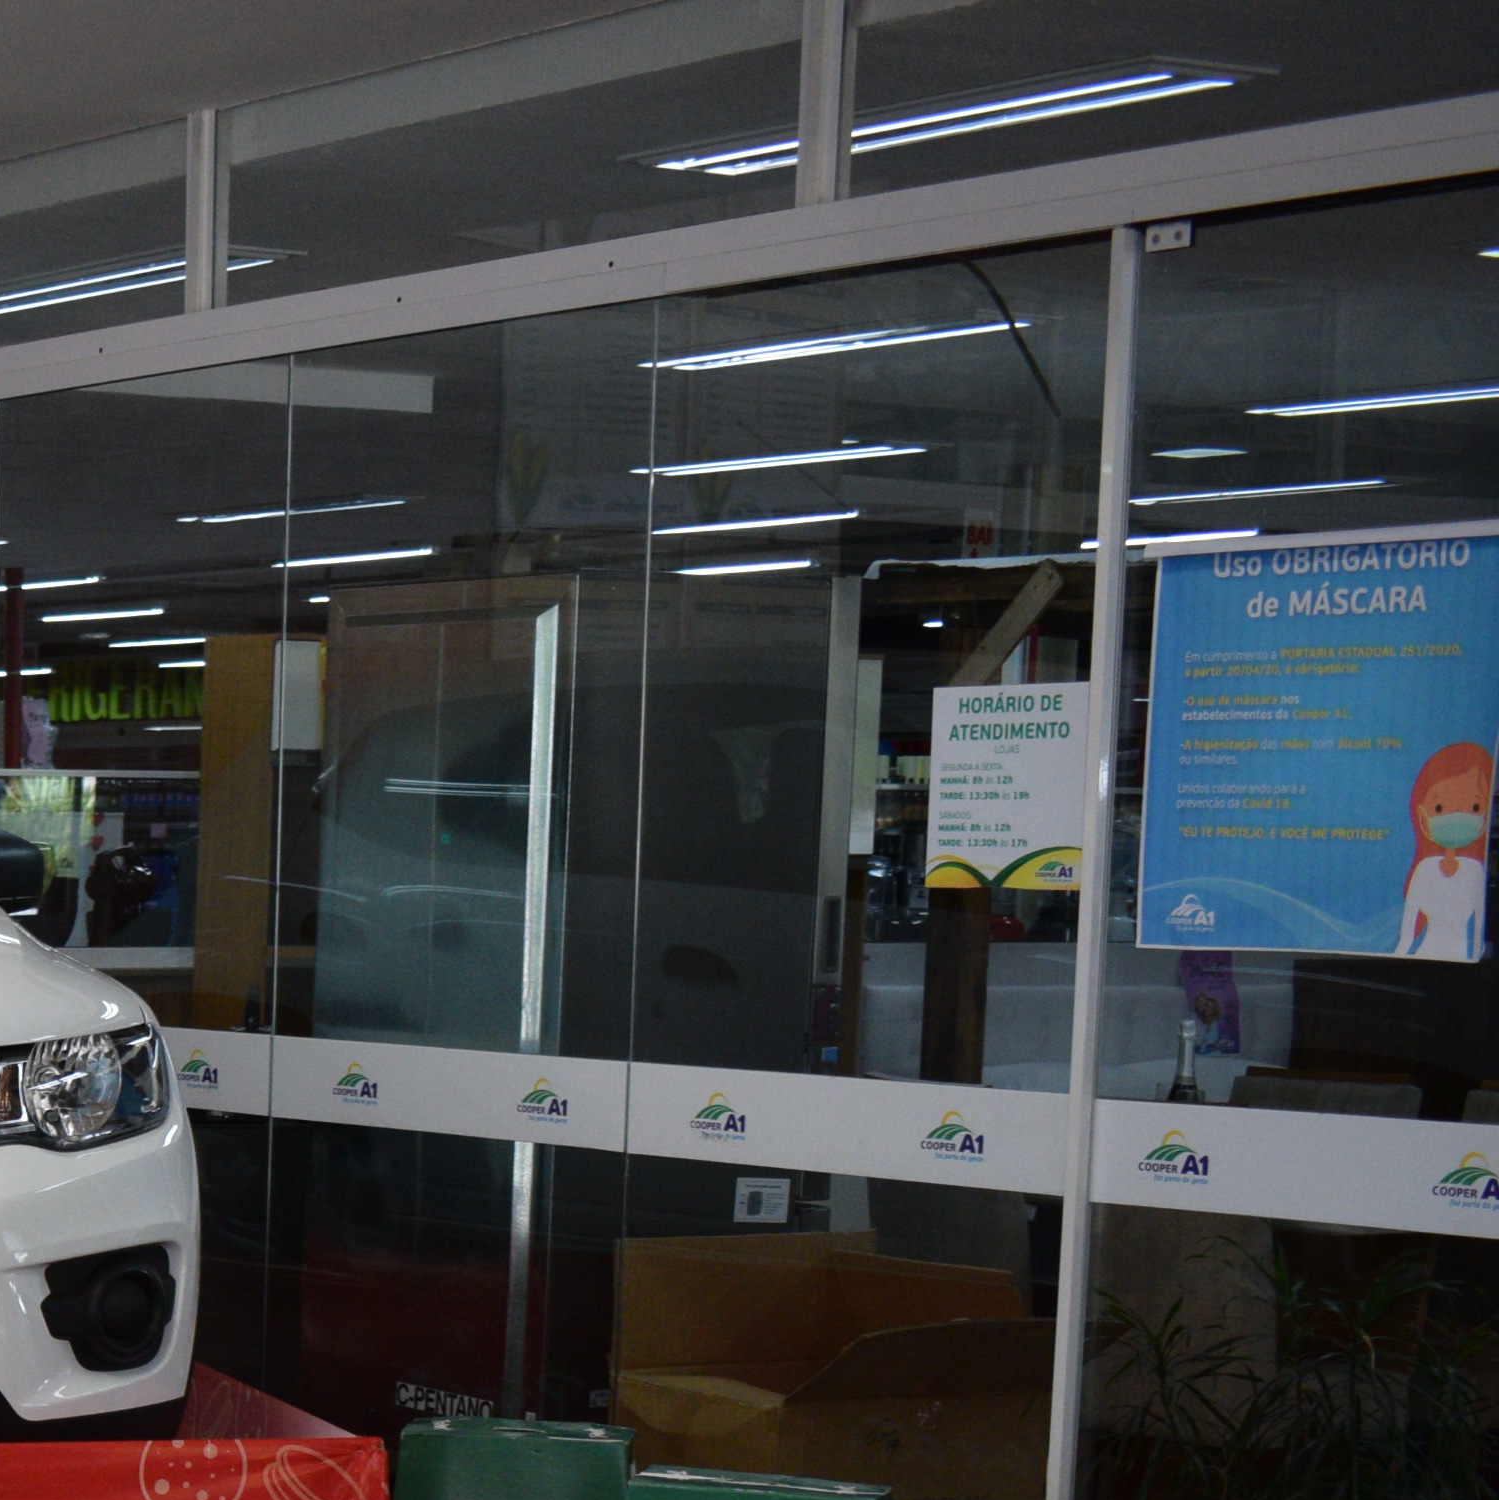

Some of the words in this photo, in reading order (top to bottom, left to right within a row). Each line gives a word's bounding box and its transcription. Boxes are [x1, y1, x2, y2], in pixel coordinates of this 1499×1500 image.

[1214, 554, 1262, 578] Uso
[1247, 592, 1278, 618] de
[1288, 582, 1427, 616] MÁSCARA
[959, 692, 1034, 714] HORÁRIO
[1040, 695, 1062, 711] DE
[949, 722, 1069, 740] ATENDIMENTO
[517, 1105, 545, 1114] COOPER
[547, 1099, 567, 1116] A1
[690, 1120, 721, 1131] COOPER
[724, 1114, 745, 1132] A1
[921, 1140, 956, 1152] COOPER
[959, 1134, 984, 1154] A1
[1139, 1162, 1178, 1173] COOPER
[1181, 1155, 1209, 1175] A1
